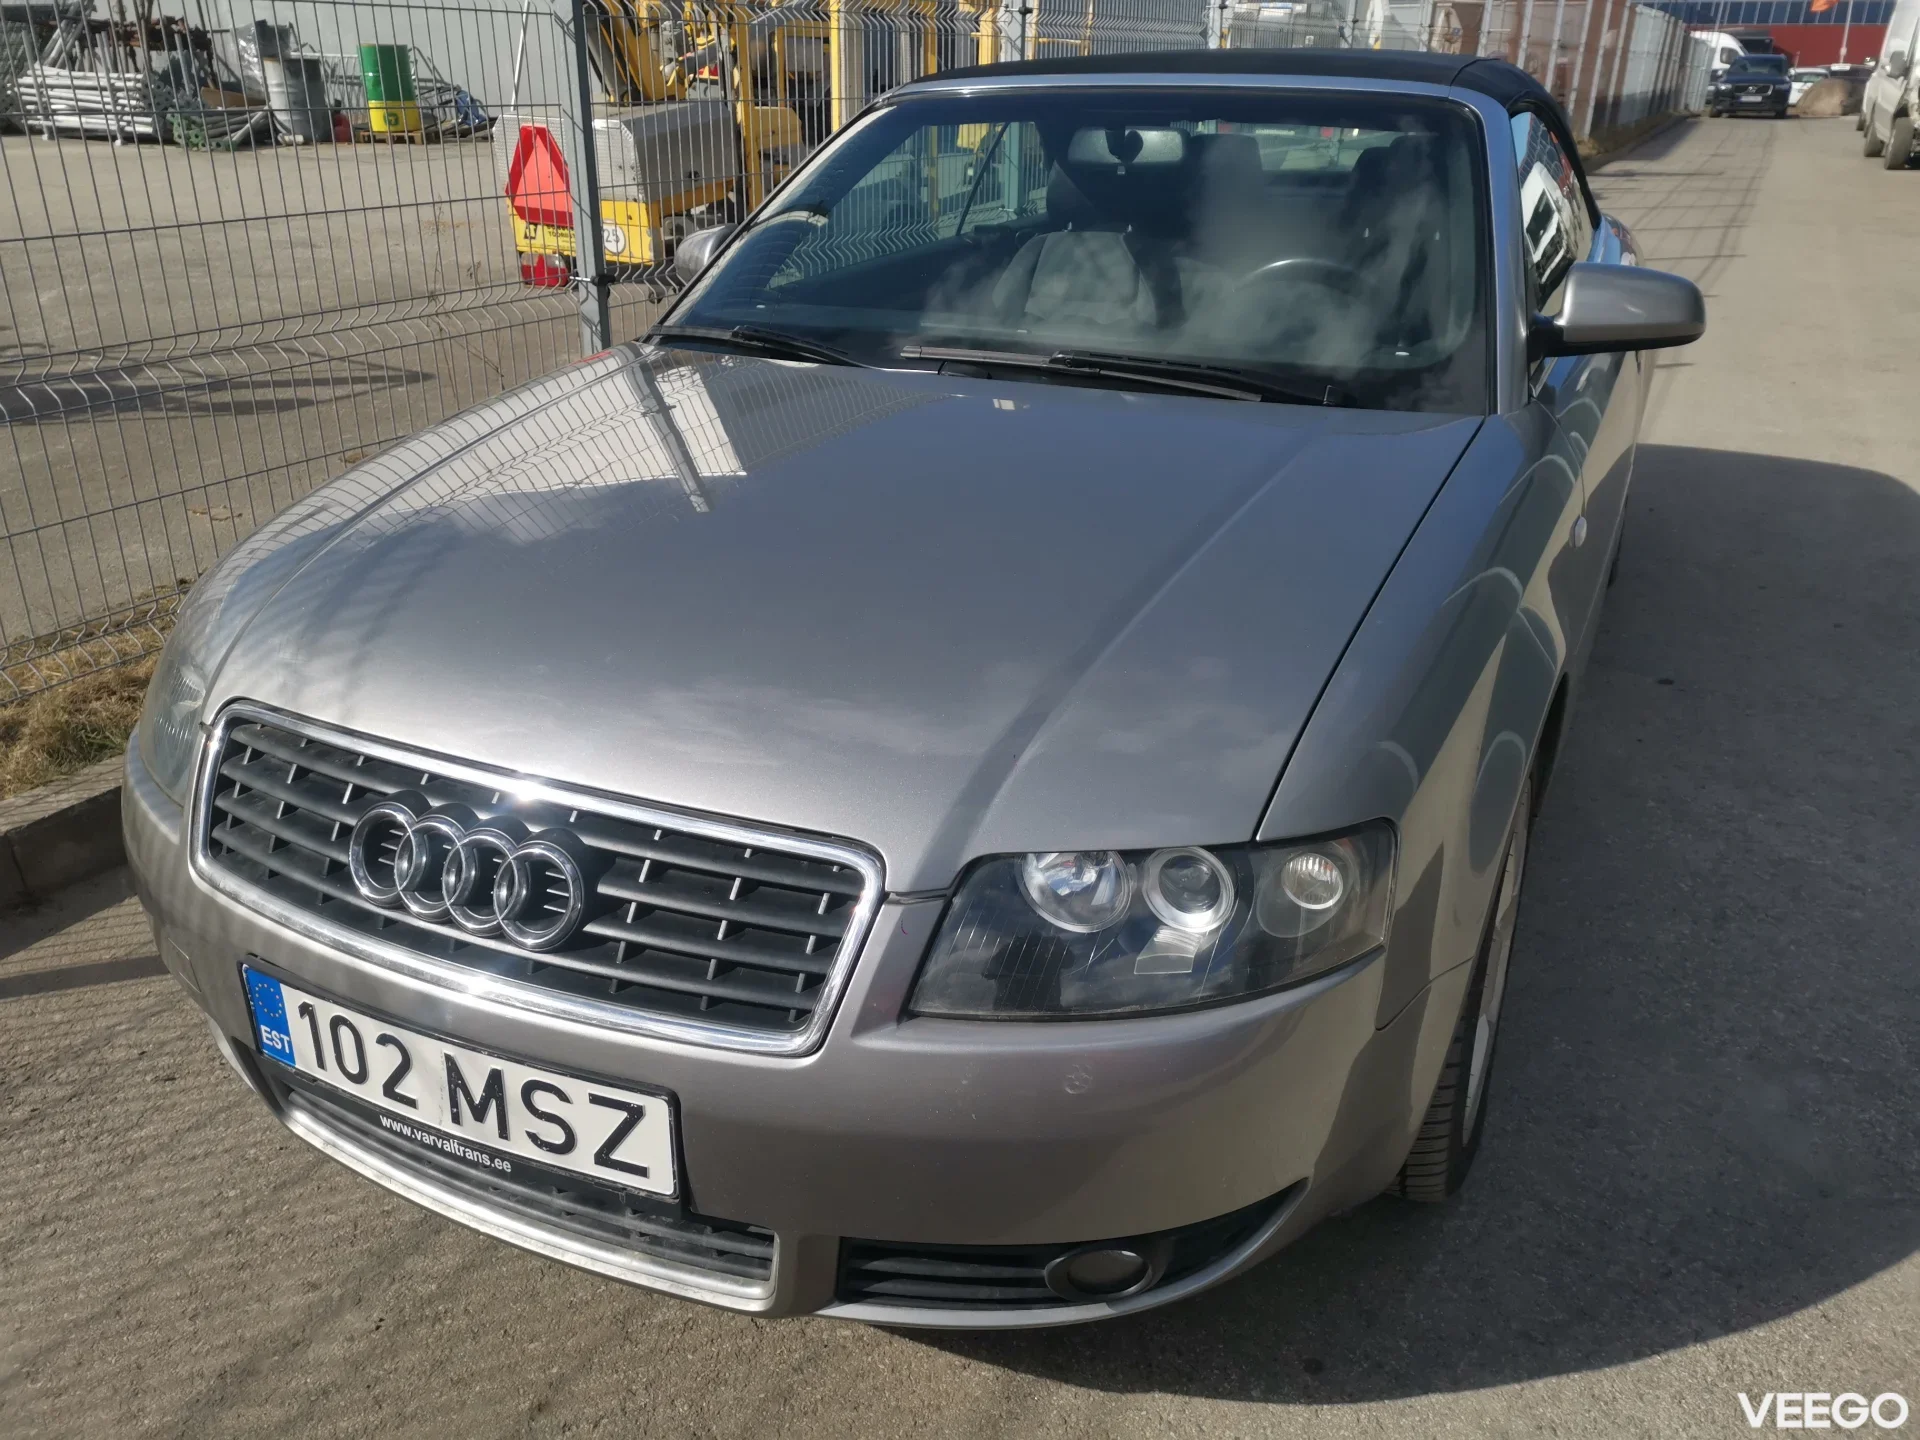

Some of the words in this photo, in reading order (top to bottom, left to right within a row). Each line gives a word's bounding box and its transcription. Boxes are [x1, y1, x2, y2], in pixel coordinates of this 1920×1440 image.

[260, 1025, 290, 1053] EST
[298, 1000, 419, 1110] 102
[444, 1052, 650, 1179] MSZ
[380, 1114, 511, 1172] www.varvaltrans.ee
